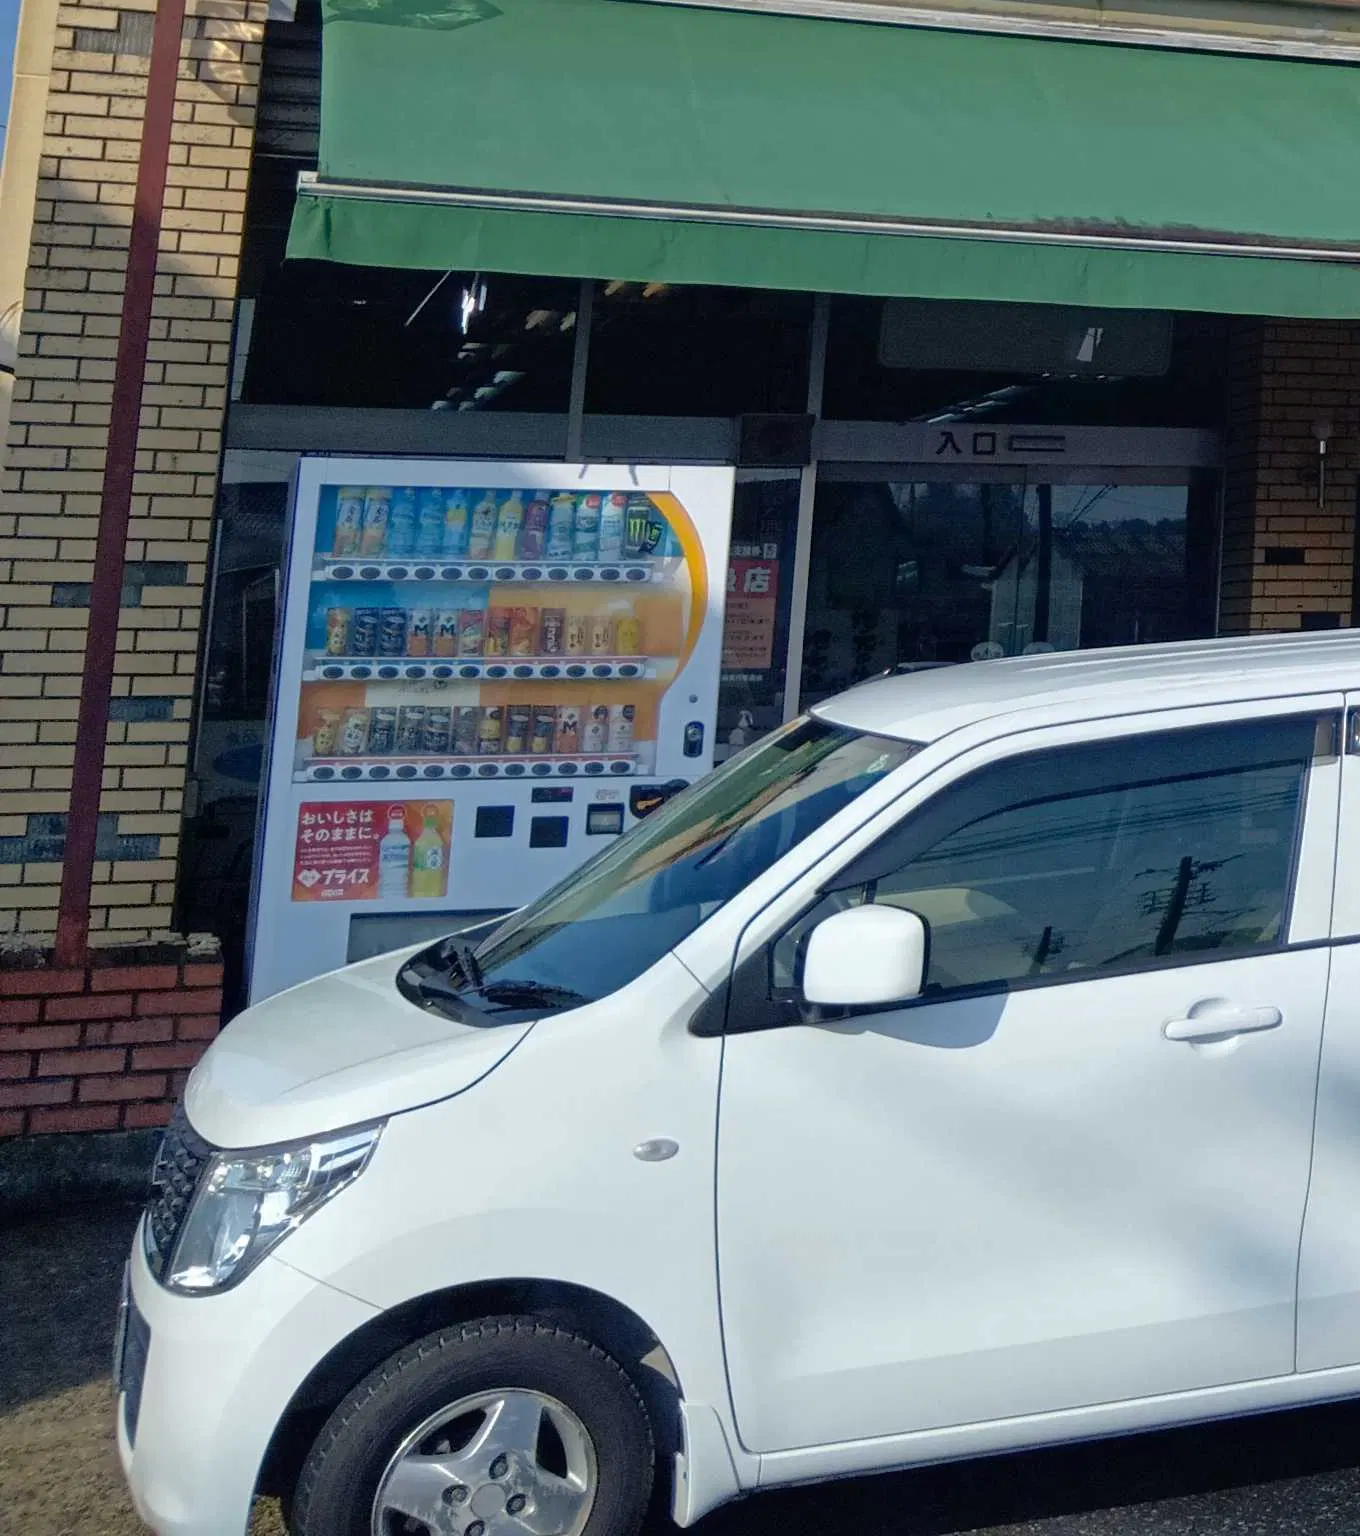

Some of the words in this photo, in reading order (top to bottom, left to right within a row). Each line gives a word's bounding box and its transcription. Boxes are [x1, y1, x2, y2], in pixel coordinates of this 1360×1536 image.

[936, 431, 997, 455] 入口
[302, 809, 375, 825] おいしさは
